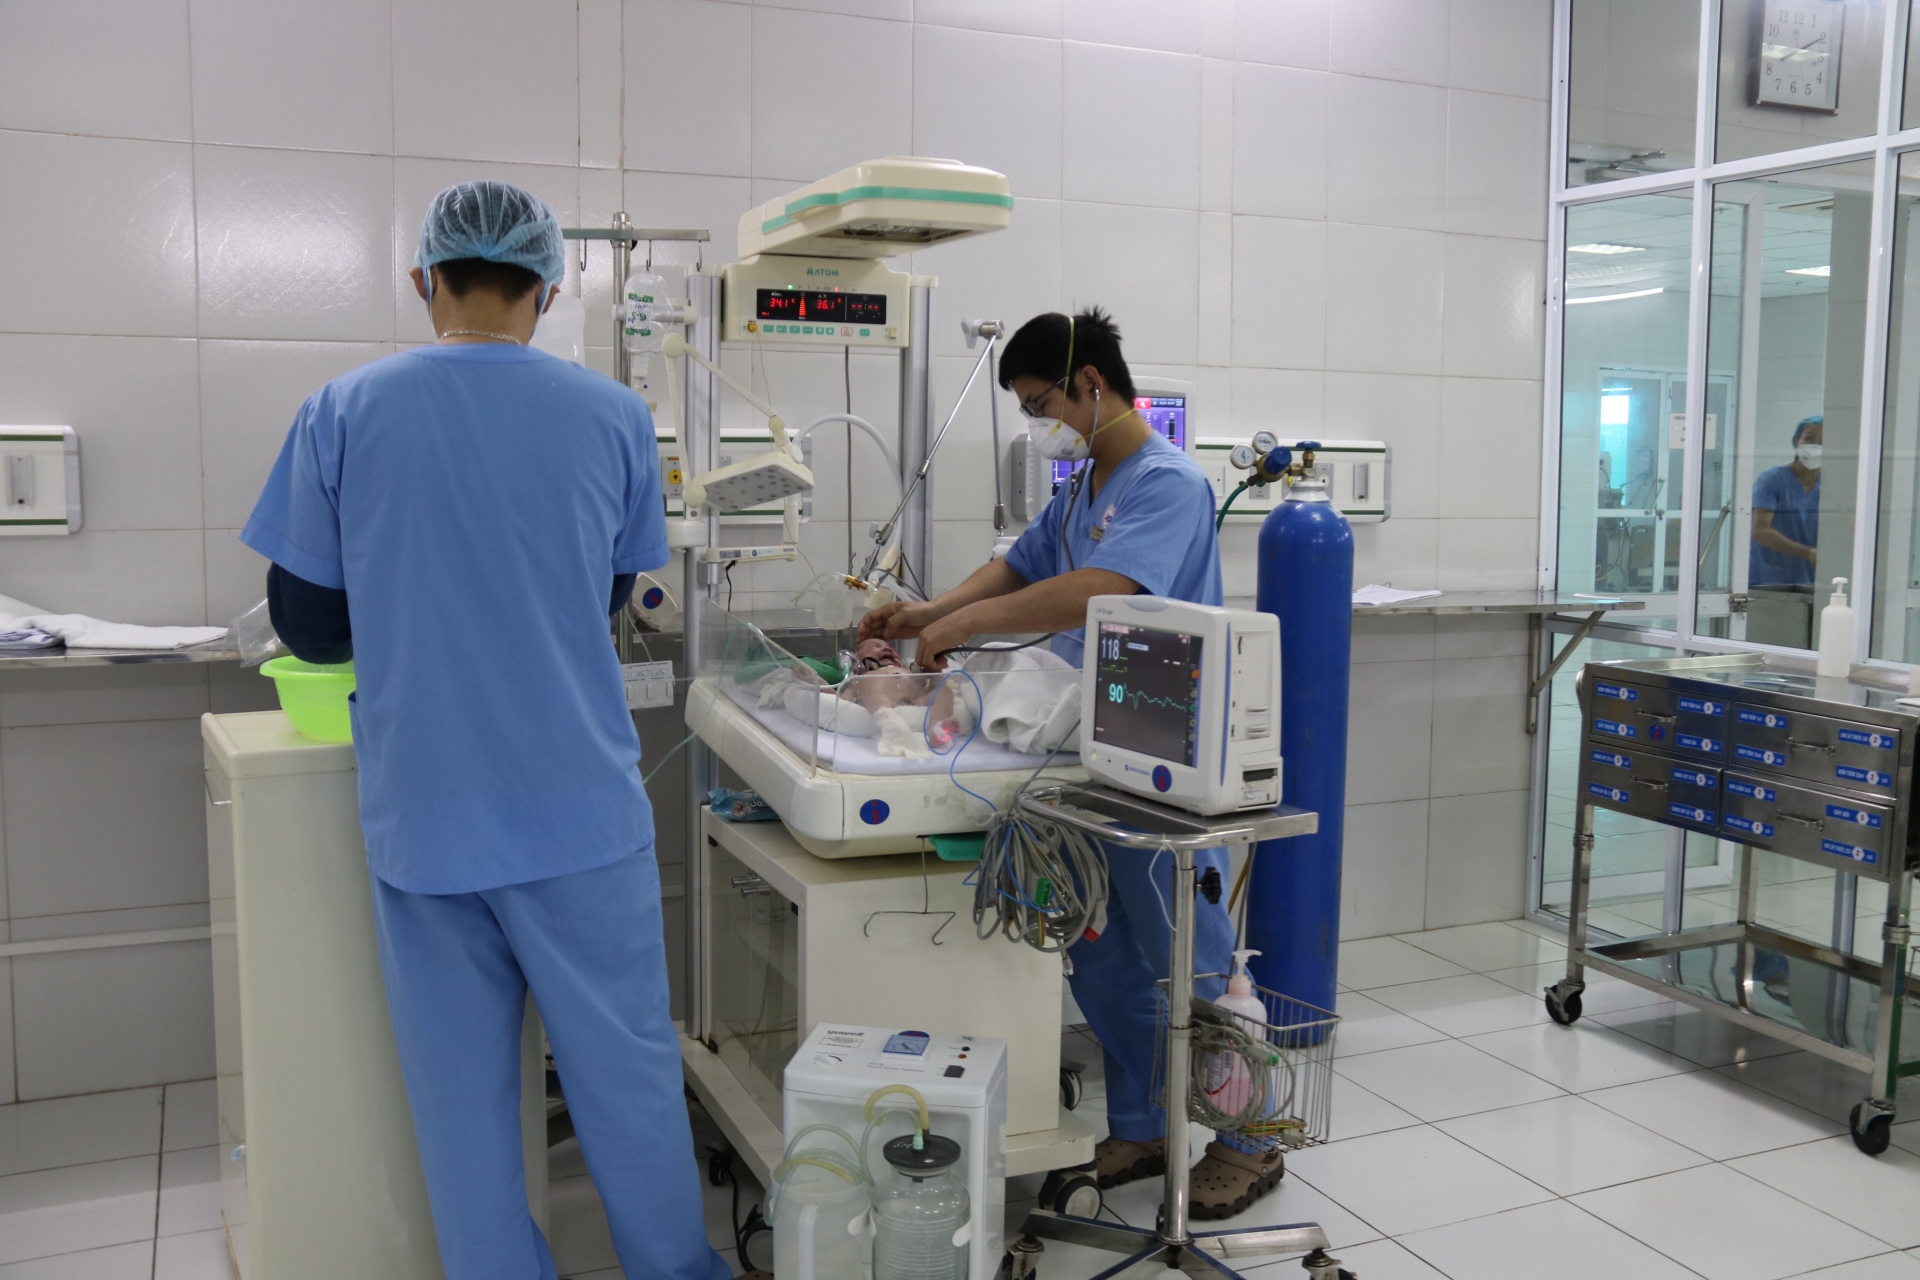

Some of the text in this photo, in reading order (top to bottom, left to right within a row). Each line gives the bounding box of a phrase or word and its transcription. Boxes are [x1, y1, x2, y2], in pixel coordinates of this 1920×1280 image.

[1778, 10, 1788, 22] 11
[1793, 12, 1805, 25] 12
[1811, 14, 1816, 27] 1
[1768, 23, 1779, 37] 10
[1820, 31, 1827, 44] 2
[1817, 51, 1824, 63] 3
[1766, 63, 1772, 75] 8
[1816, 72, 1823, 84] 4
[1775, 79, 1782, 91] 7
[1790, 81, 1797, 94] 6
[1805, 83, 1812, 95] 5
[814, 268, 839, 276] ATOM
[1101, 636, 1120, 660] 118
[1109, 683, 1123, 703] 90
